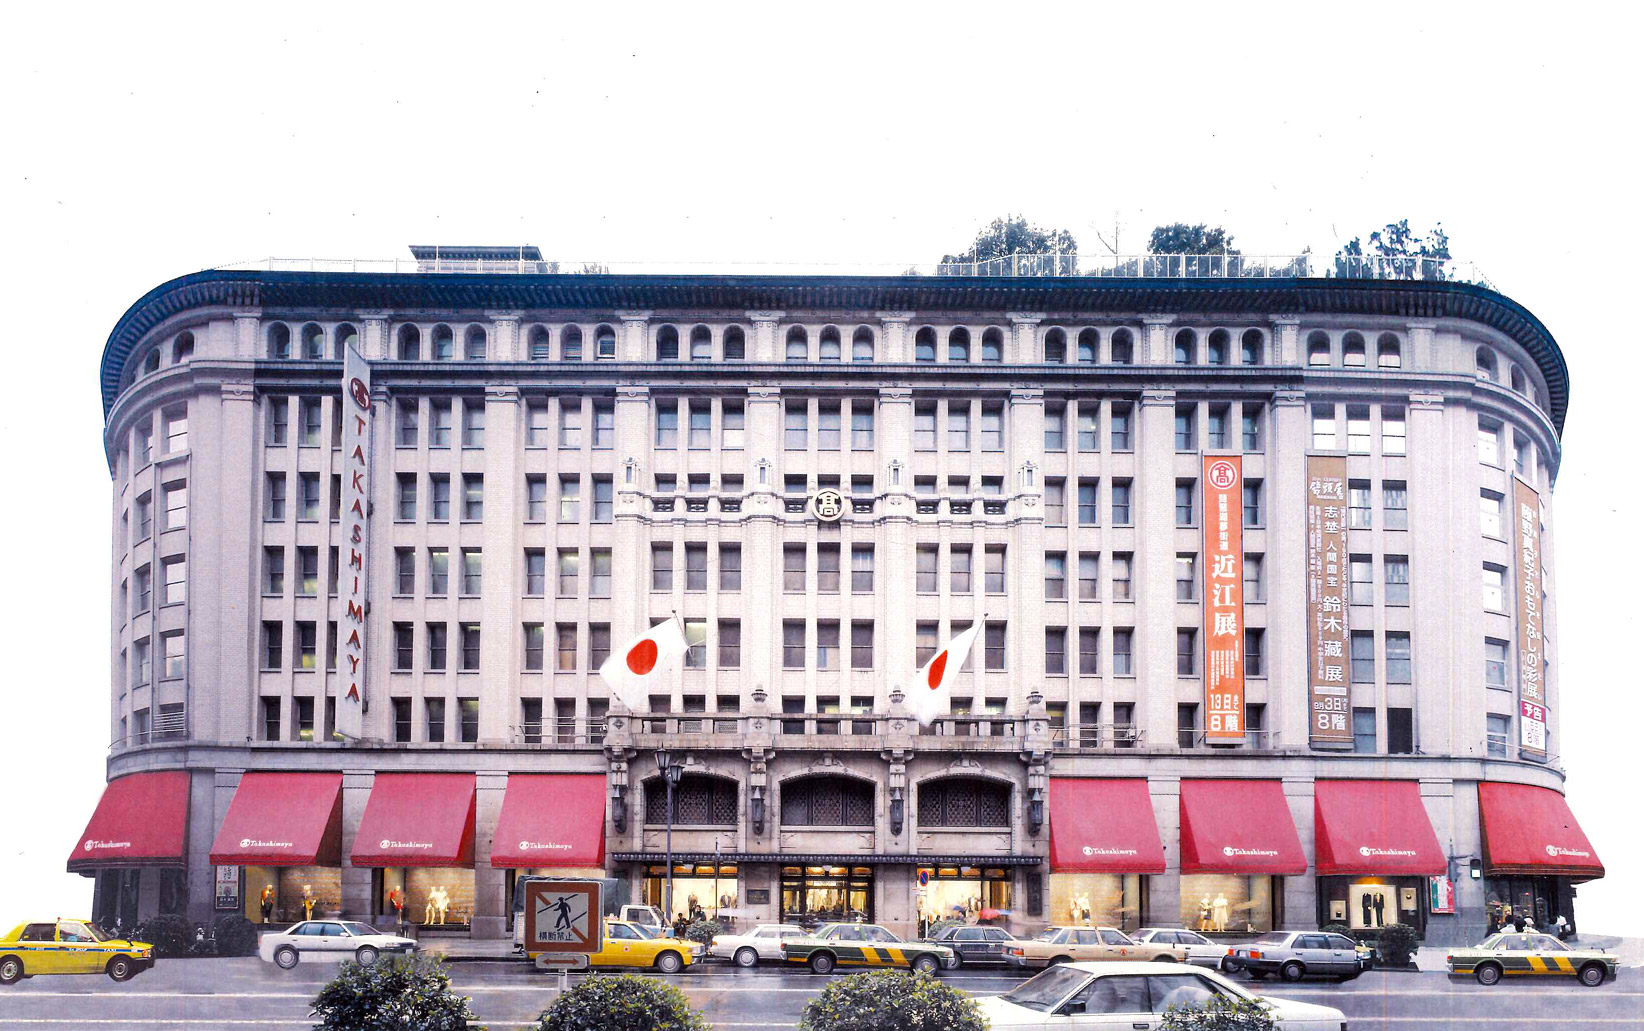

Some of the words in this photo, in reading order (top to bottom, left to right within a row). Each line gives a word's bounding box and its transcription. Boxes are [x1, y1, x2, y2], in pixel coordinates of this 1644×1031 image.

[346, 414, 366, 703] TAKASHIMAYA
[1211, 554, 1237, 638] 近江展
[1210, 715, 1239, 732] 8階
[1317, 713, 1346, 731] 8階
[538, 931, 573, 941] 横断禁止
